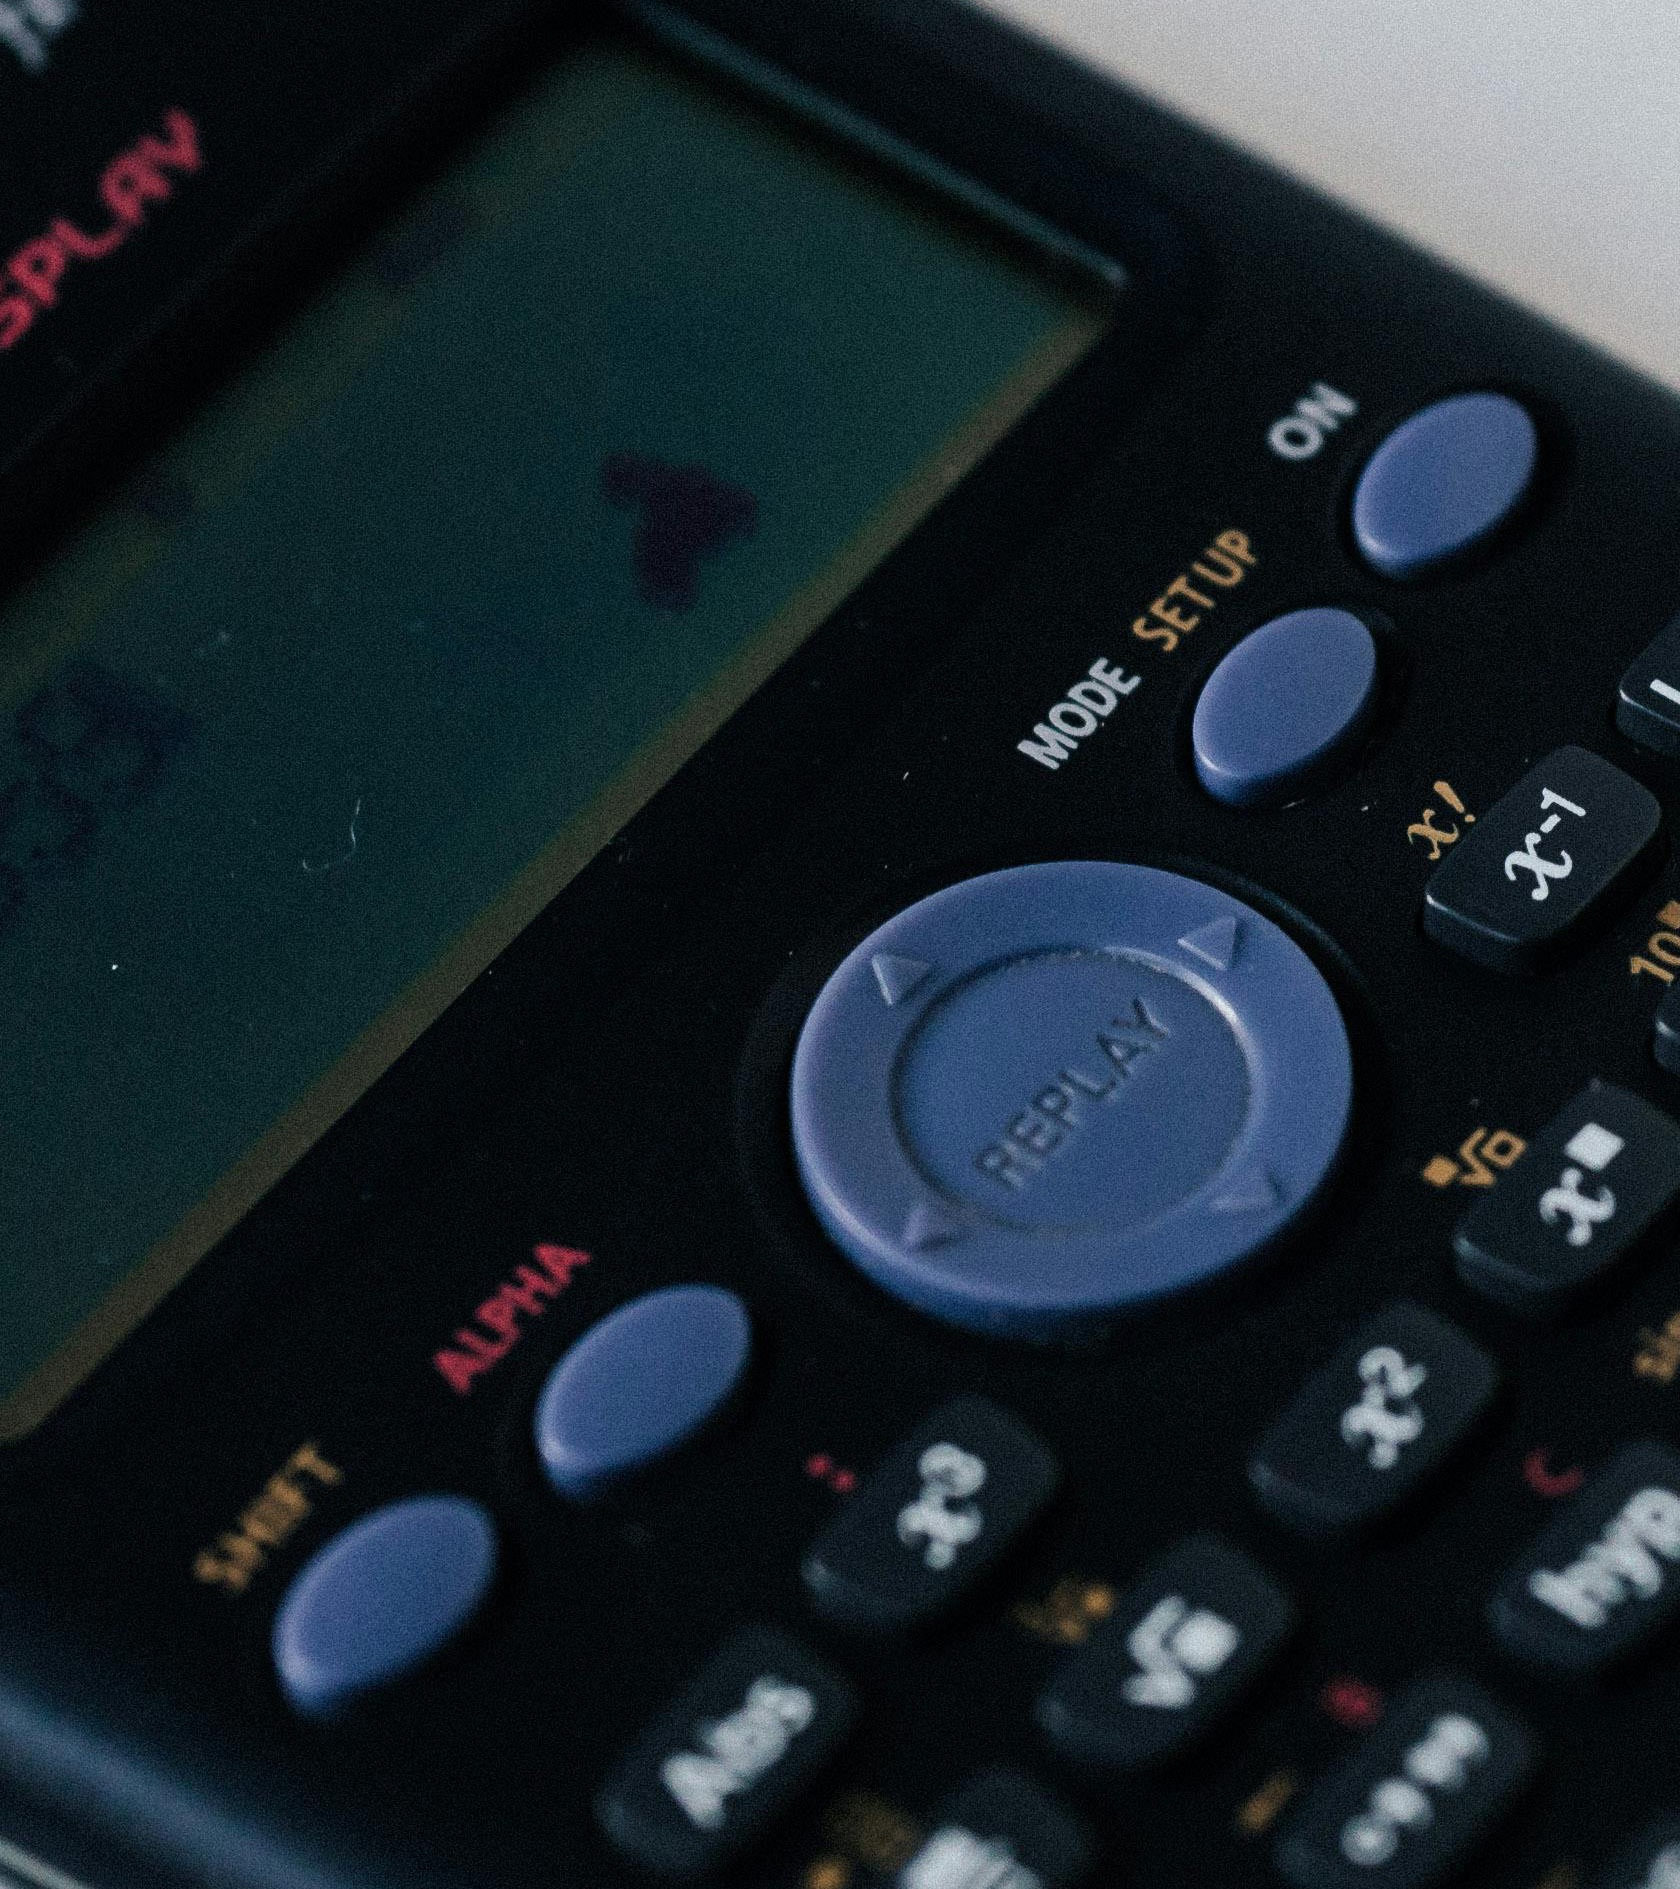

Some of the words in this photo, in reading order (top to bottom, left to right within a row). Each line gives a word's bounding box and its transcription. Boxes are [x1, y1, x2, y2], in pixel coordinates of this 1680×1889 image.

[1267, 383, 1356, 460] ON
[1017, 657, 1141, 770] MODE
[975, 997, 1171, 1193] REPLAY
[434, 1242, 591, 1395] ALPHA
[195, 1443, 342, 1592] SHIFT
[662, 1679, 814, 1826] Abs
